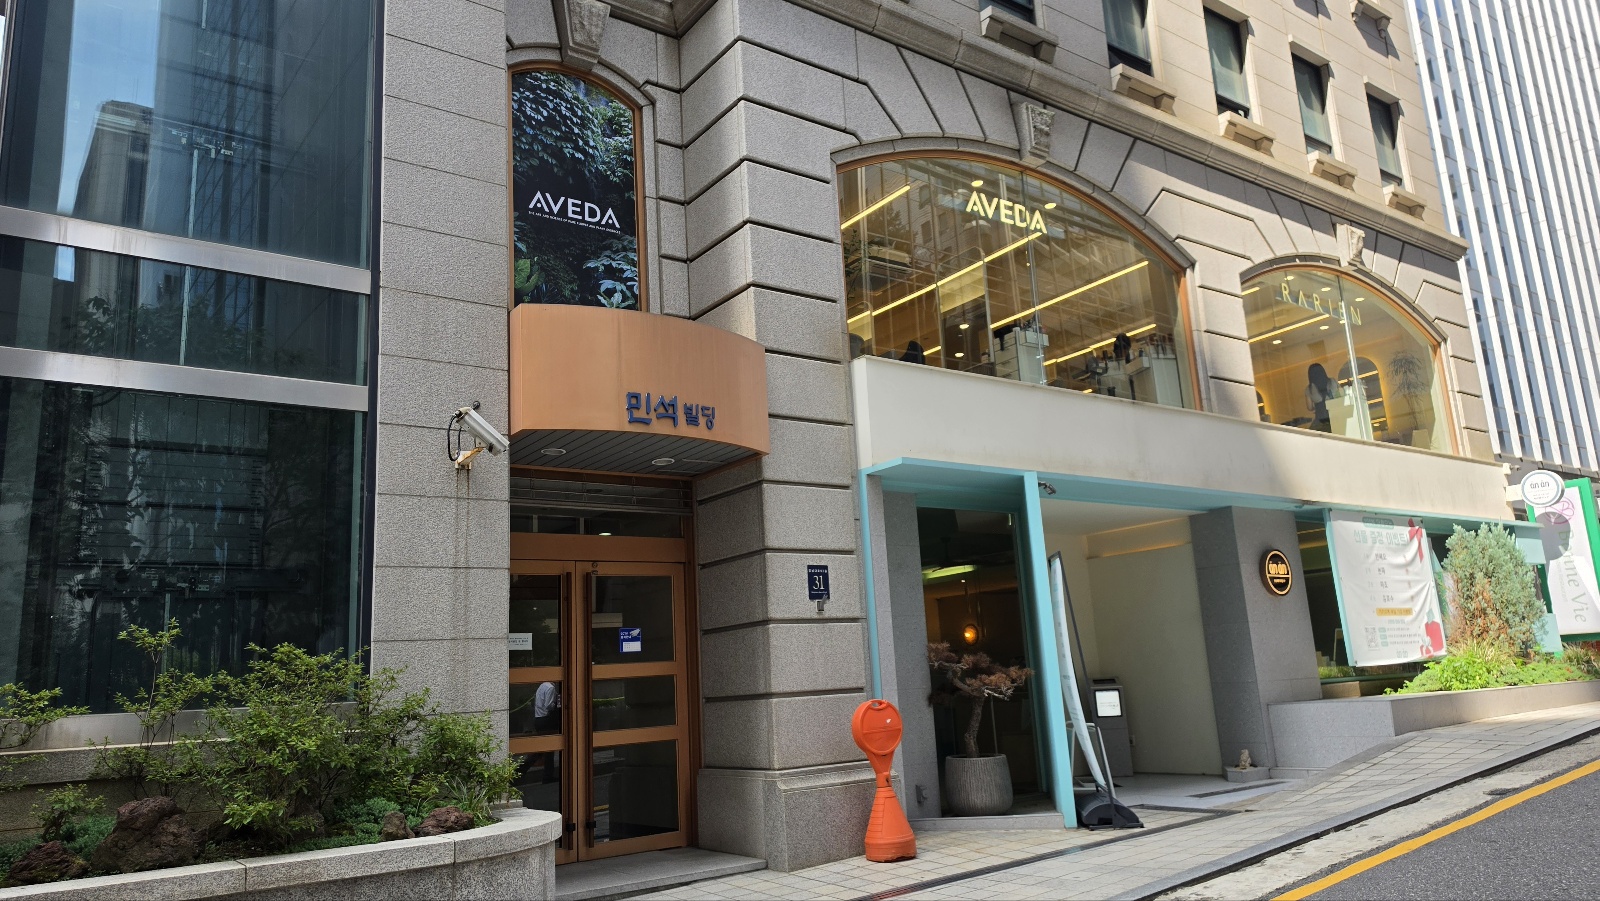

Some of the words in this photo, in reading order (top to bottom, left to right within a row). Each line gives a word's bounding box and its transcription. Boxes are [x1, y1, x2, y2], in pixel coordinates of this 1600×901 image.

[528, 190, 621, 228] AVEDA
[965, 190, 1048, 234] AVEDA
[1281, 282, 1362, 326] RARIEN
[625, 391, 679, 428] 민석
[683, 402, 716, 431] 빌딩
[1353, 530, 1368, 544] 선물
[1370, 531, 1384, 545] 증정
[812, 575, 825, 590] 31
[1571, 593, 1590, 623] Vie
